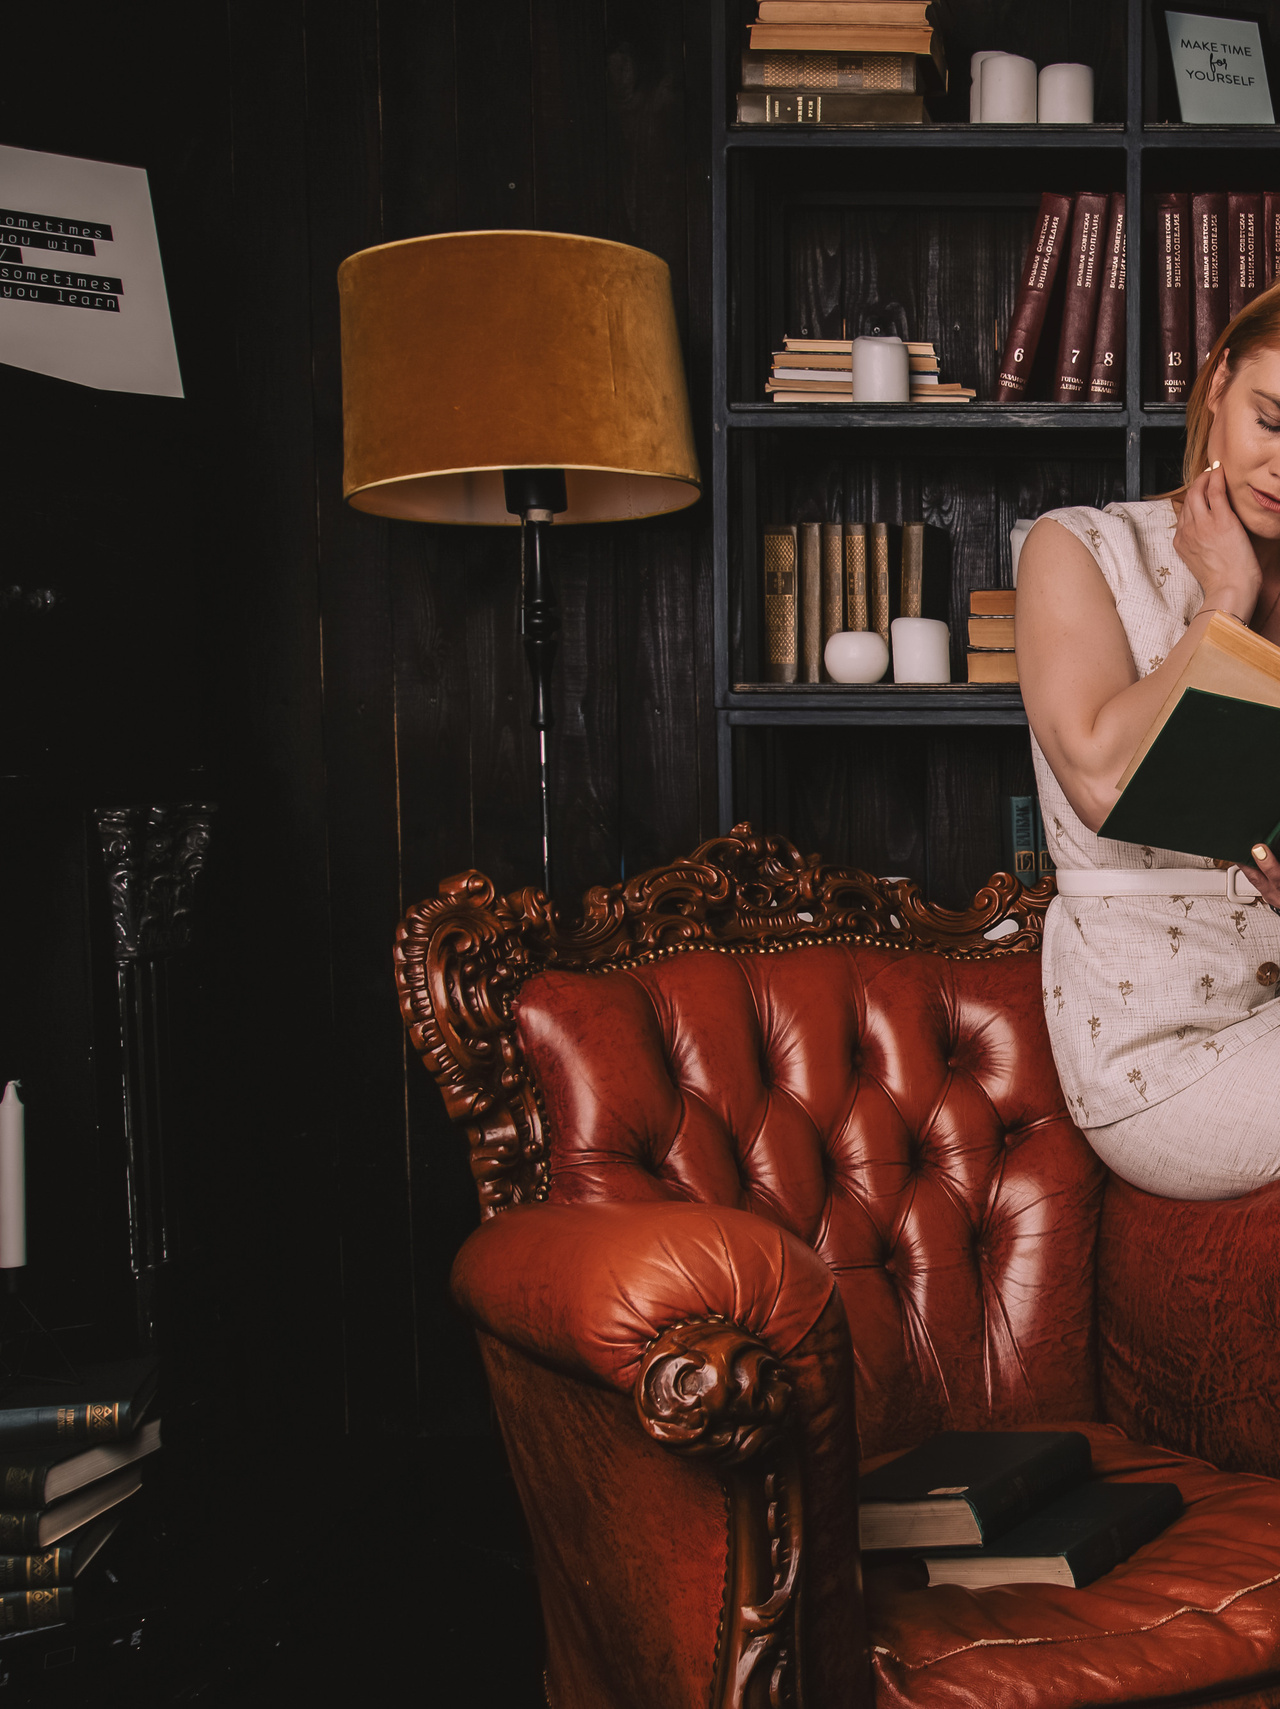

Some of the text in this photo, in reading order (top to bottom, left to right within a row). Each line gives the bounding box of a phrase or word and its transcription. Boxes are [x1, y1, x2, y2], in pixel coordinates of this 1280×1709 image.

[1180, 38, 1252, 57] MAKE TIME
[1209, 53, 1228, 73] for
[1186, 69, 1255, 88] YOURSELF
[0, 216, 102, 239] ometimes
[47, 239, 82, 252] win
[1028, 214, 1050, 287] БОЛЬШАЯ СОВЕТСКАЯ
[1037, 216, 1059, 289] ЭНЦИКЛОПЕДИЯ
[1076, 212, 1090, 287] БОЛЬШАЯ СОВЕТСКАЯ
[1085, 214, 1100, 288] ЭНЦИКЛОПЕДИЯ
[1110, 214, 1124, 289] БОЛЬШАЯ СОВЕТСКАЯ
[1, 268, 111, 291] sometimes
[3, 286, 116, 308] you learn
[1014, 348, 1024, 362] 6
[1071, 350, 1081, 363] 7
[1104, 352, 1114, 367] 8
[1167, 351, 1182, 367] 13
[1018, 854, 1031, 870] 15
